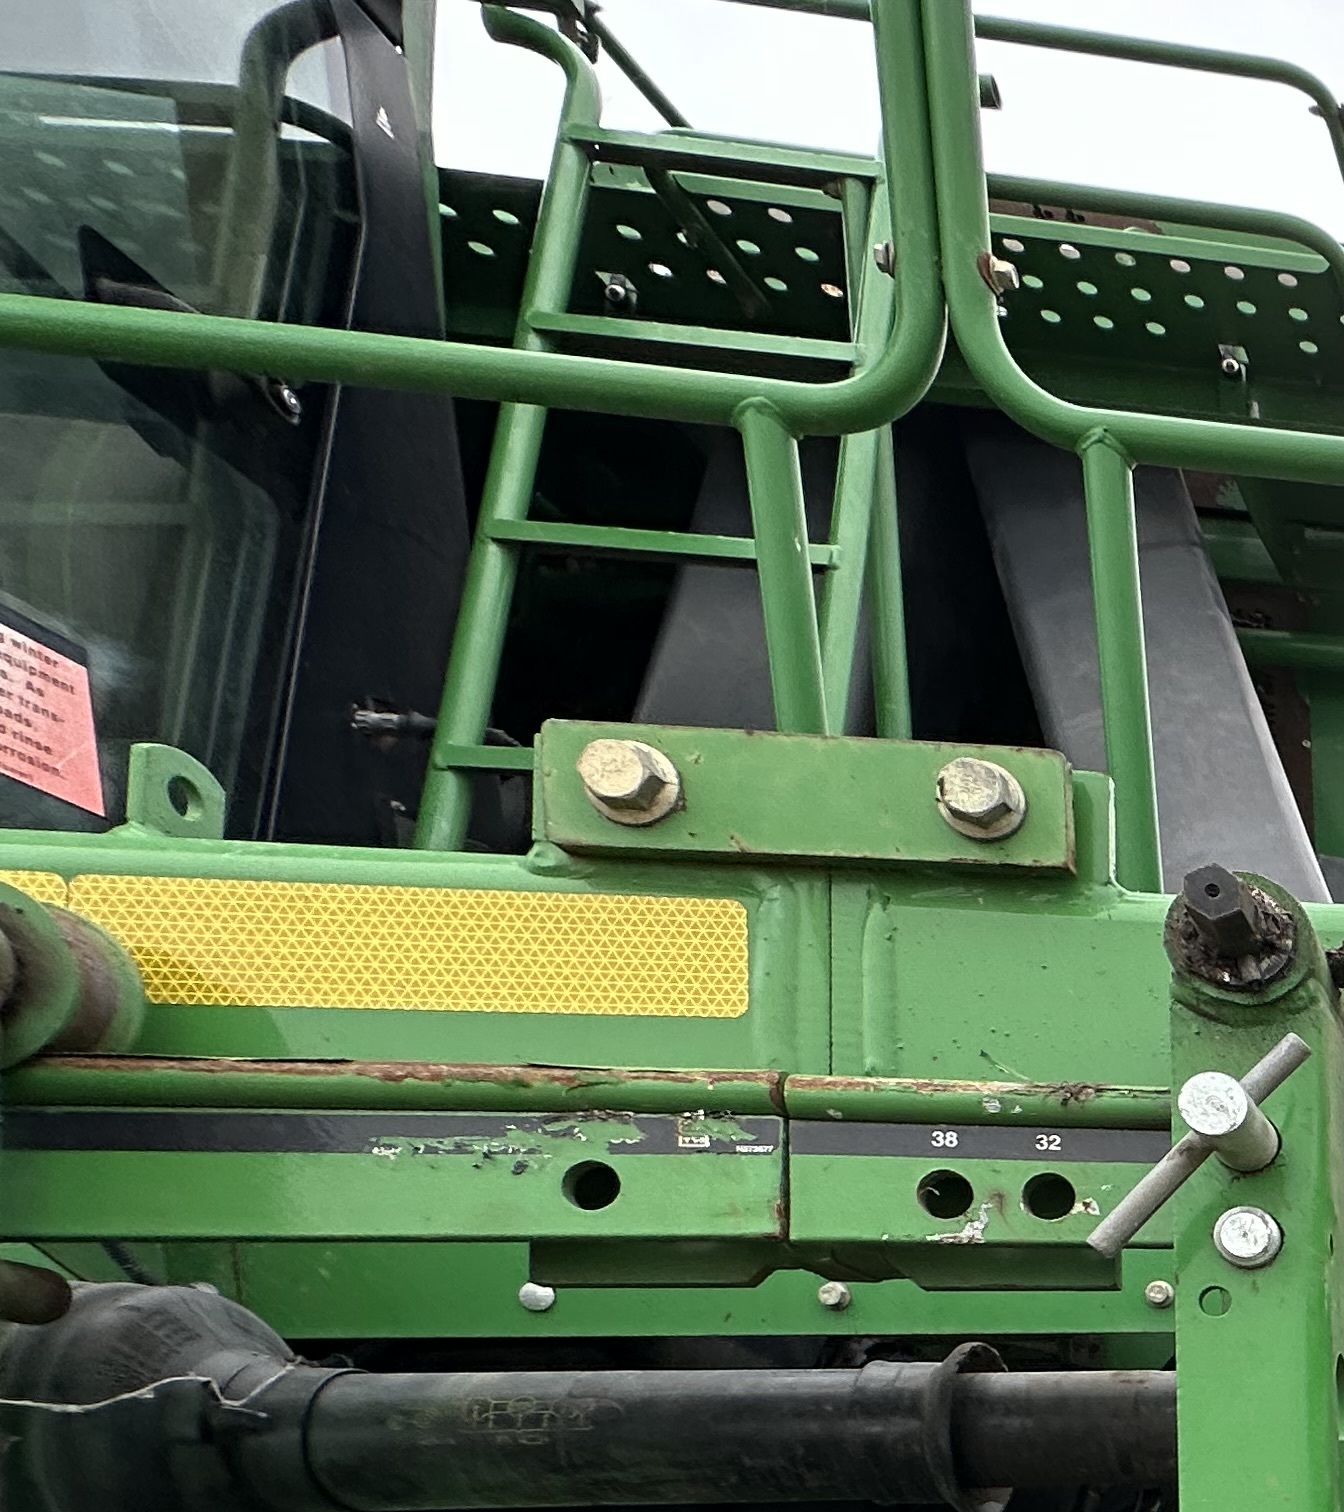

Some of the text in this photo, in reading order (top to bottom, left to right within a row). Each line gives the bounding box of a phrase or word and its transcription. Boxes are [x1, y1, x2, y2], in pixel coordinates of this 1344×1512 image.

[10, 638, 59, 668] winter
[26, 680, 45, 698] As
[12, 730, 53, 756] rinse
[930, 1130, 959, 1148] 38
[1035, 1134, 1062, 1151] 32
